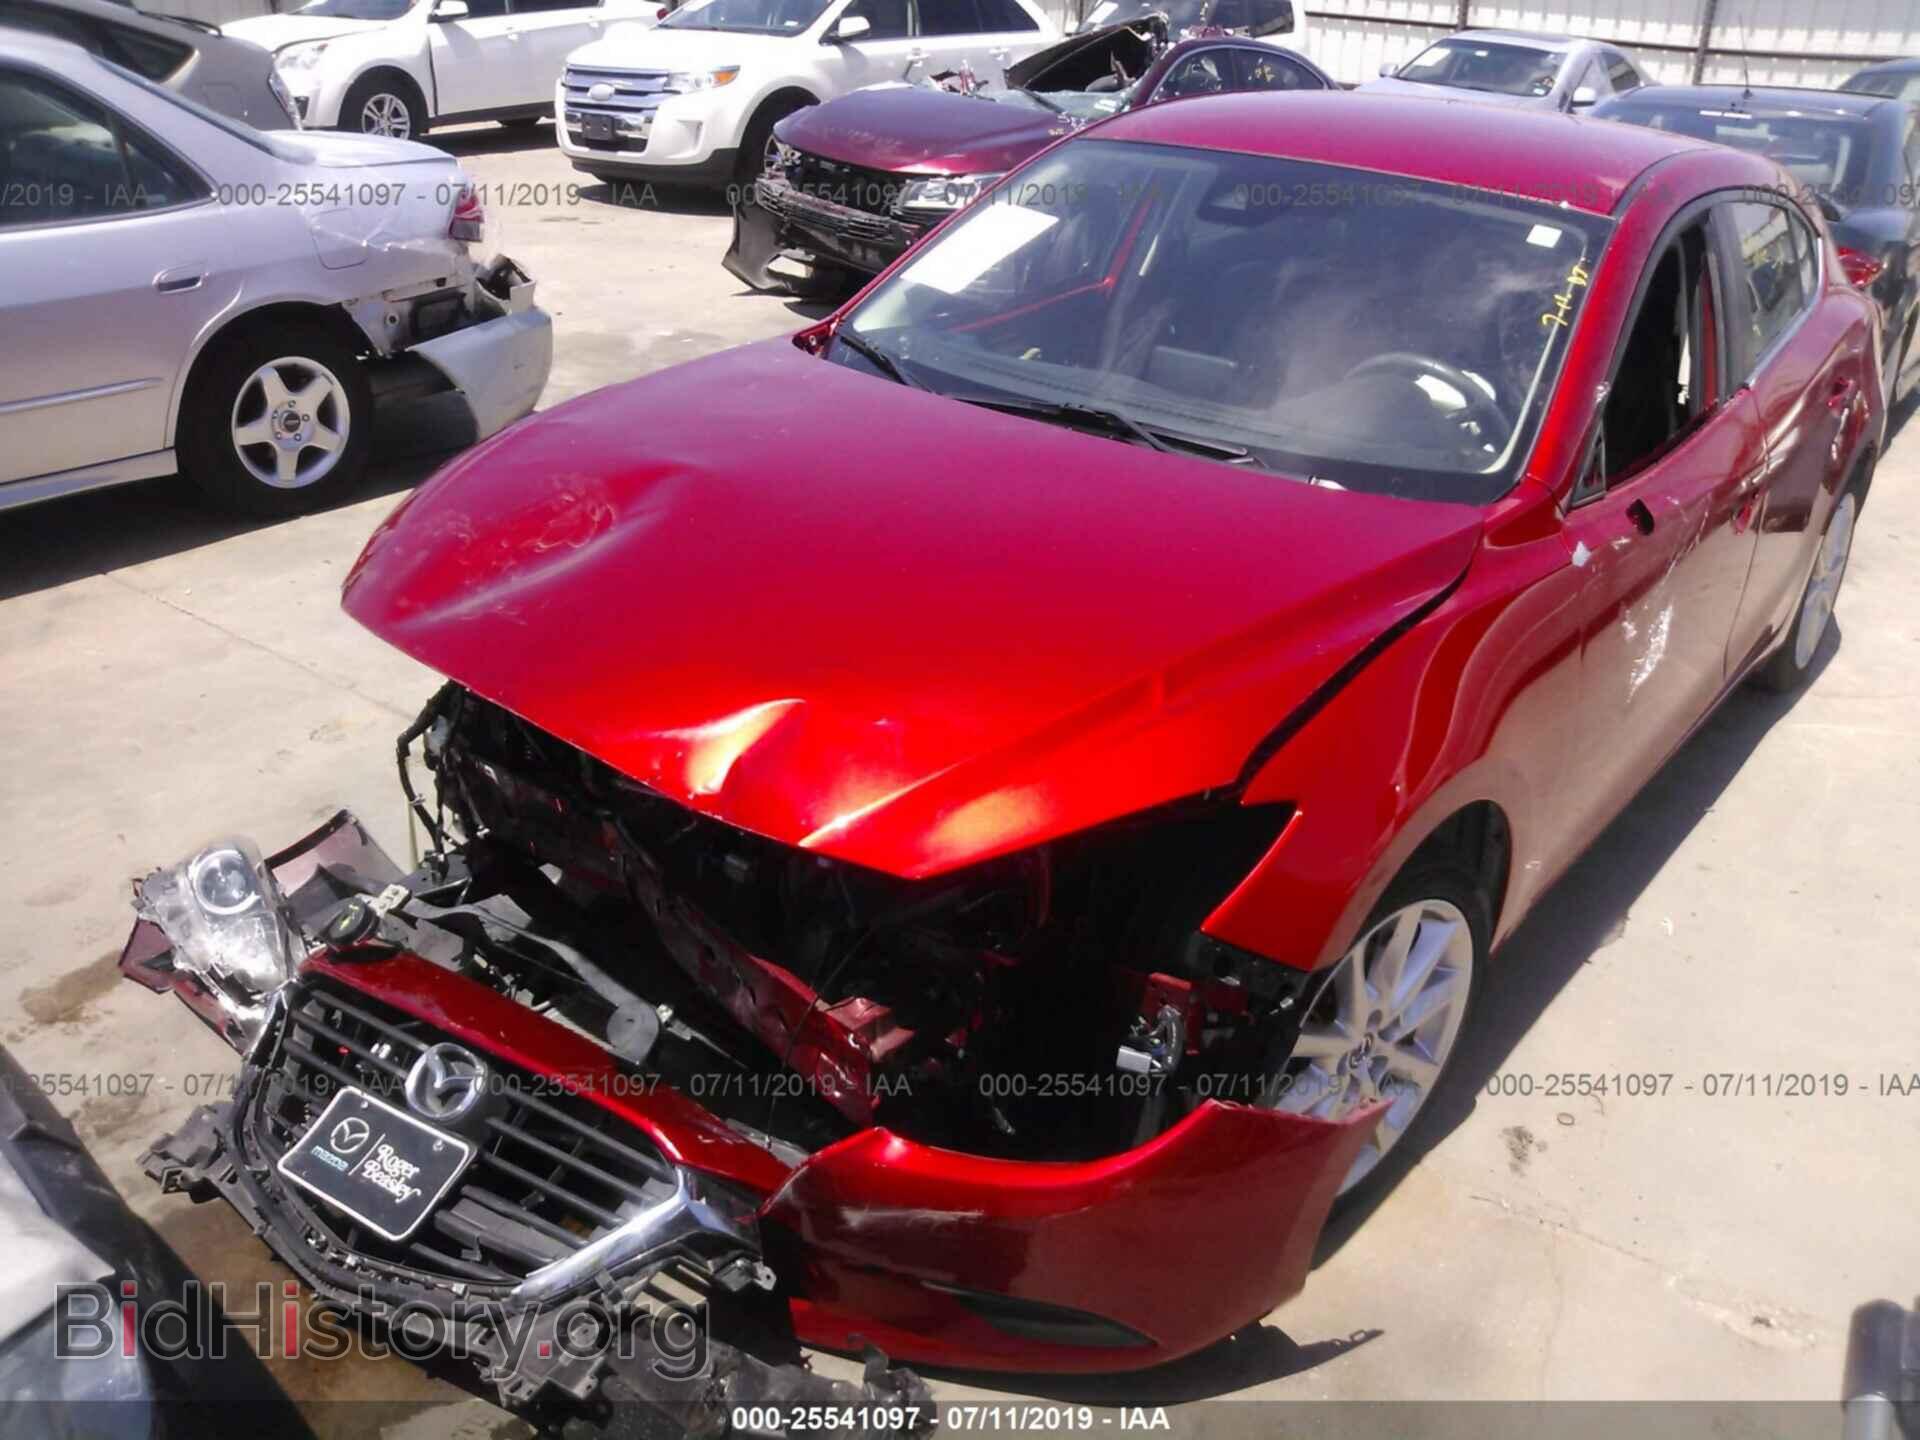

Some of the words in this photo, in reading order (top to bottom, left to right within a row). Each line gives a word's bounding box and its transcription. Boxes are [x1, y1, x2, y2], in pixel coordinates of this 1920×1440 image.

[312, 1145, 348, 1172] mazda
[377, 1144, 420, 1179] Roger
[362, 1160, 421, 1203] Beasley
